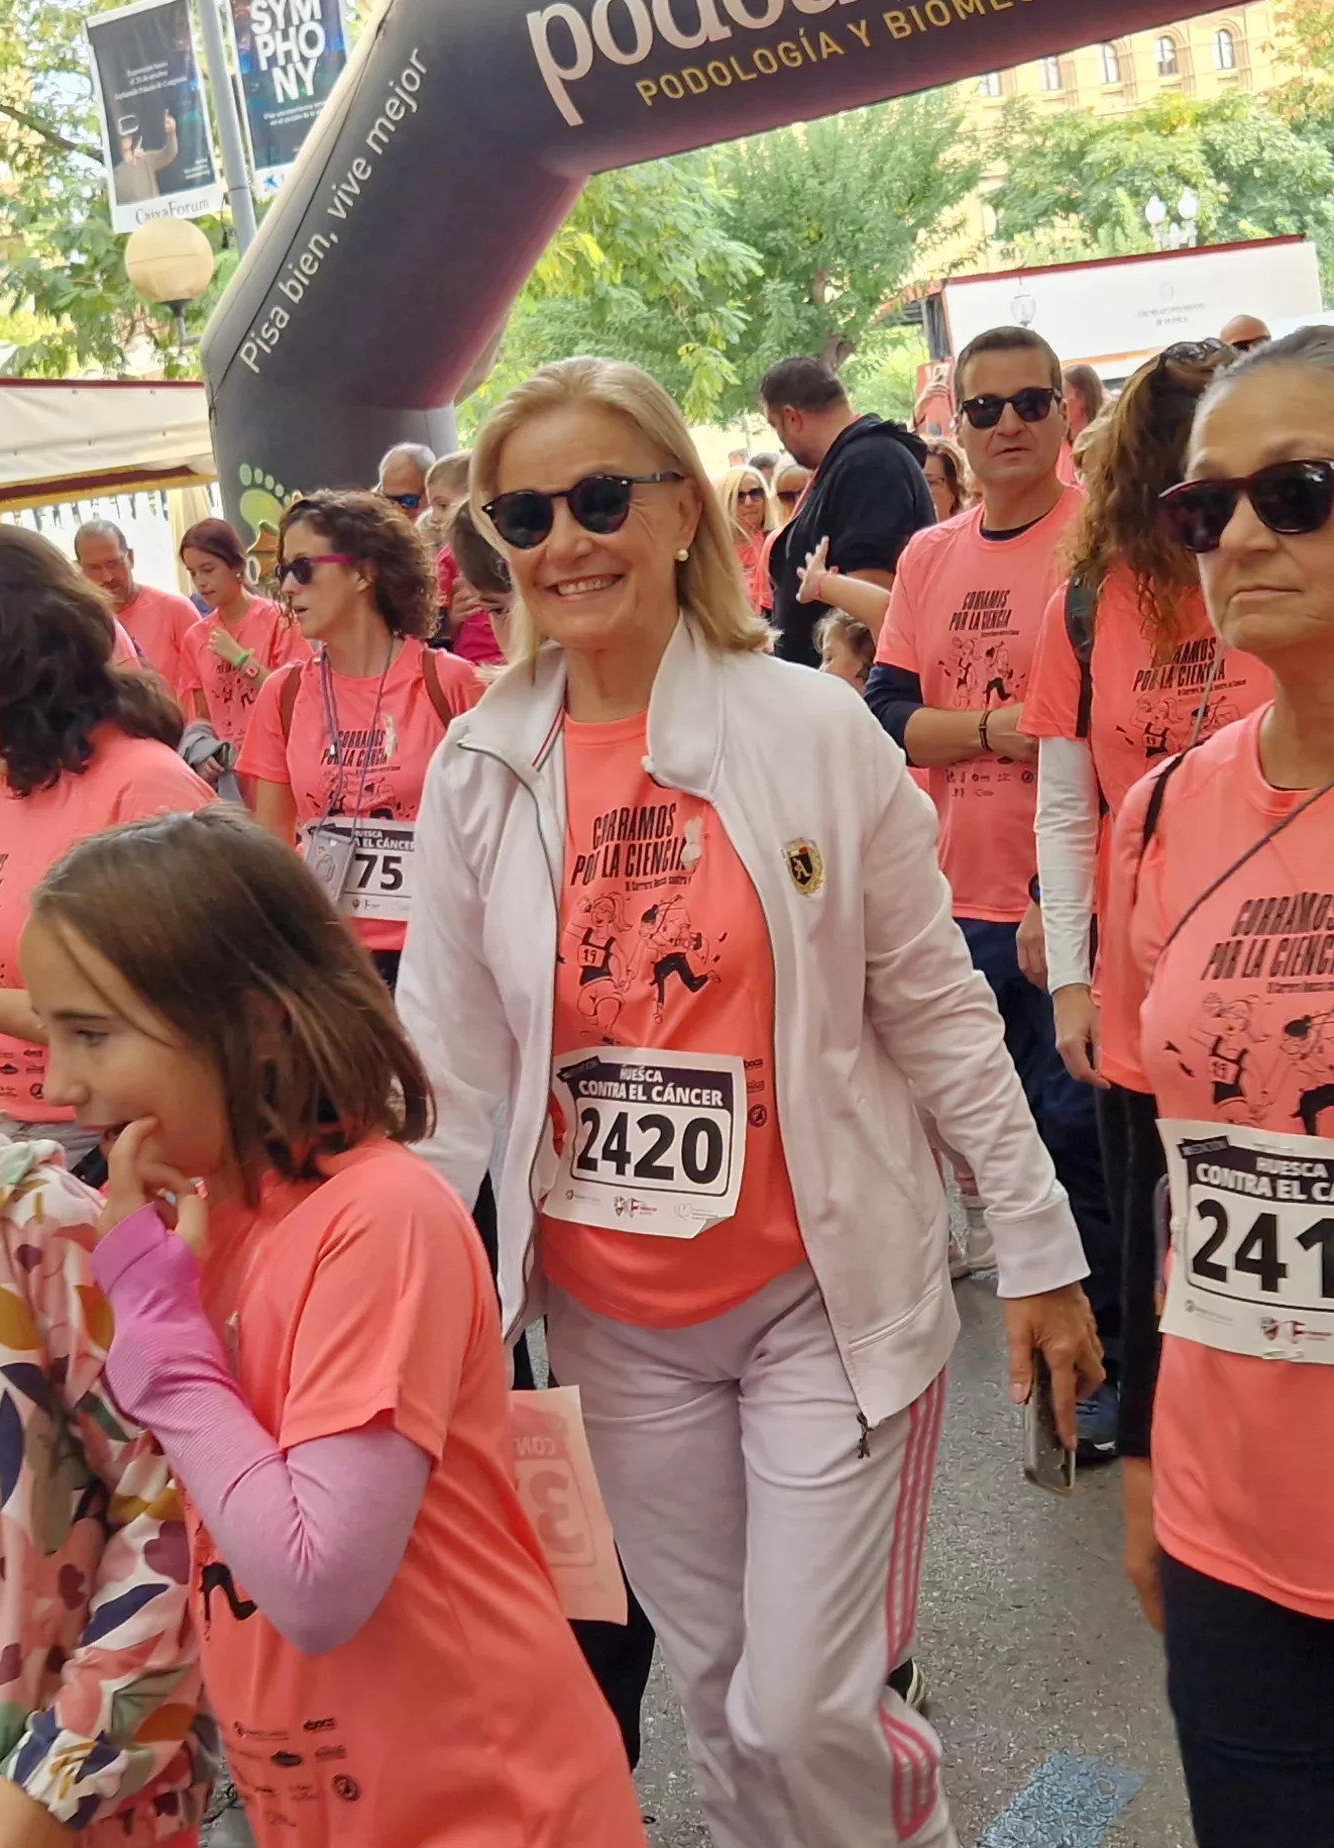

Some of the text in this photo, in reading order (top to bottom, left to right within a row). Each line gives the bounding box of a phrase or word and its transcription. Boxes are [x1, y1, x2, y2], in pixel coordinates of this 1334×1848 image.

[255, 21, 325, 72] PHO
[635, 27, 845, 107] PODOLOGÍA
[847, 19, 871, 47] Y
[271, 59, 317, 103] NY
[135, 198, 210, 226] CaixaForum
[239, 47, 428, 373] Pisa bien, vive mejor
[602, 843, 619, 878] LA
[1241, 938, 1270, 979] LA
[619, 1064, 663, 1083] HUESCA
[578, 1080, 627, 1100] CONTRA
[628, 1084, 647, 1101] EL
[651, 1082, 724, 1107] CÁNCER
[576, 1107, 724, 1185] 2420
[1196, 1163, 1273, 1198] CONTRA
[1276, 1179, 1308, 1200] EL
[1256, 1156, 1329, 1178] HUESCA
